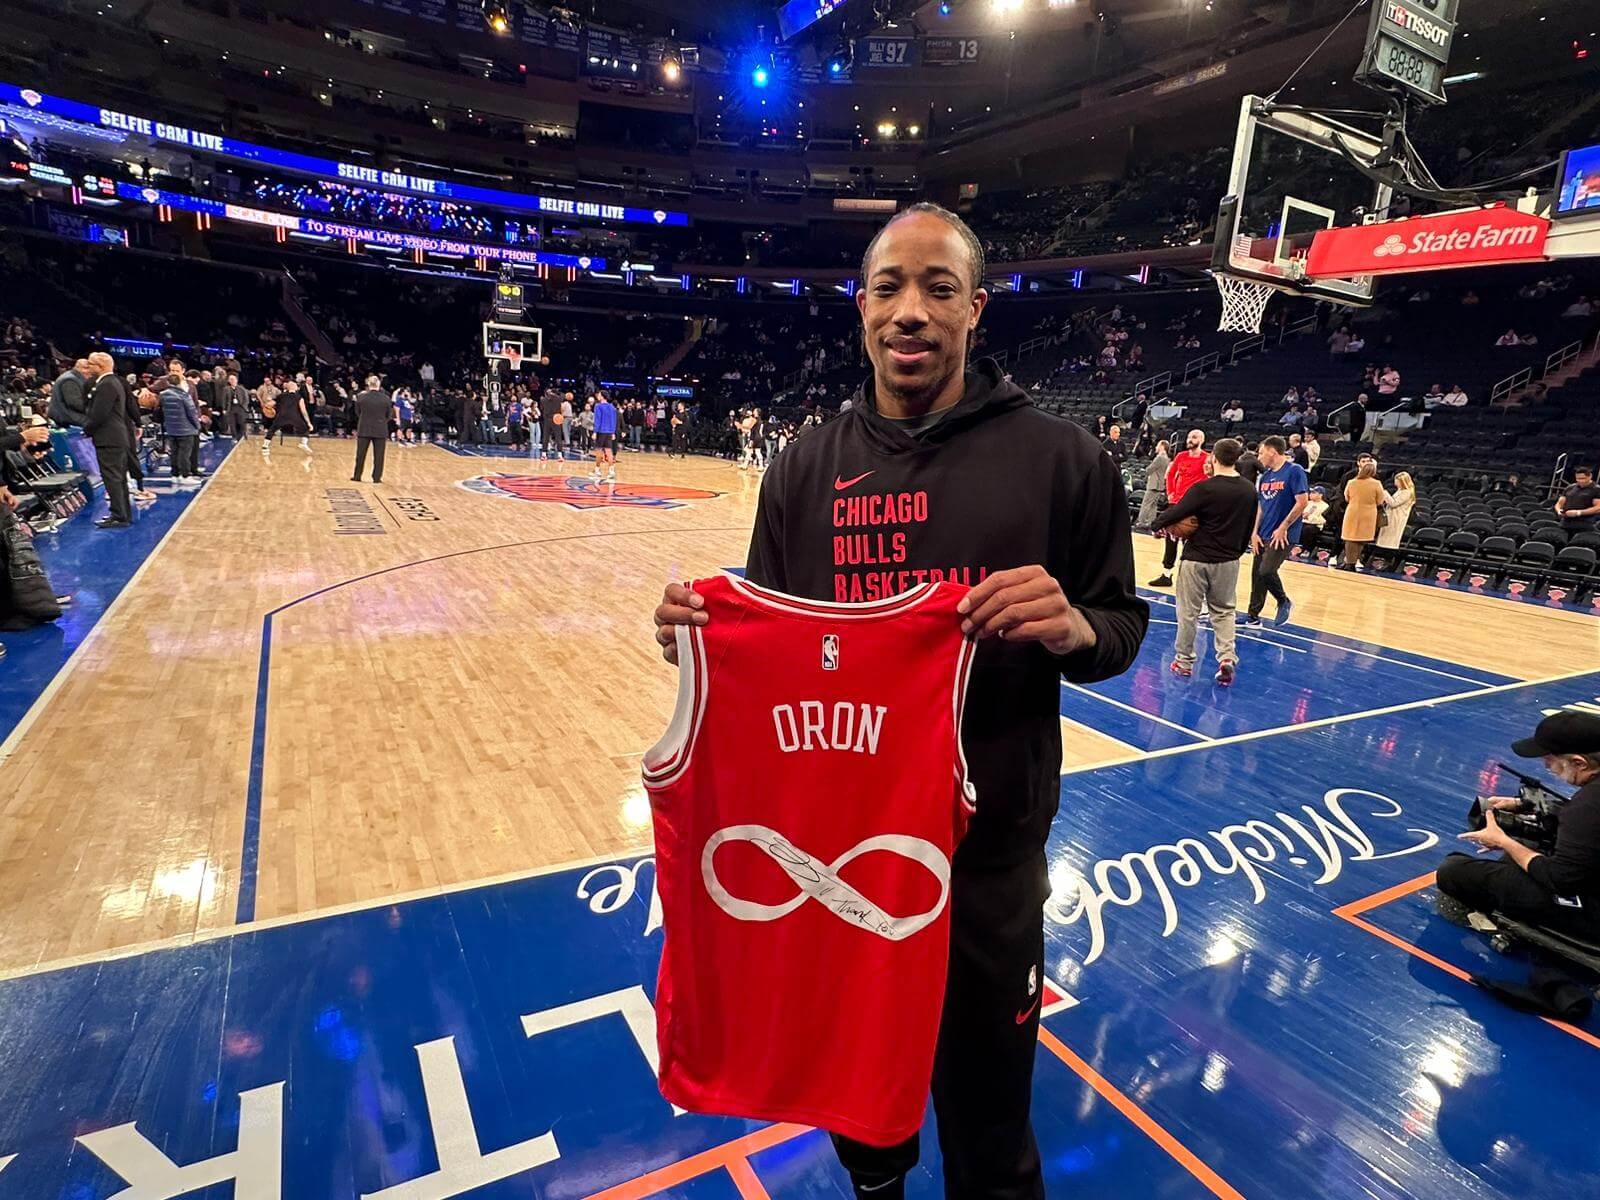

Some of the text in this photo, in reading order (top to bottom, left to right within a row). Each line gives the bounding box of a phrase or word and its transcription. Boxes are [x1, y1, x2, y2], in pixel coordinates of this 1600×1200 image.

[1405, 11, 1449, 47] TISSOT
[869, 42, 885, 52] BILLY
[869, 53, 884, 63] JOEL
[886, 42, 907, 63] 97
[958, 40, 978, 59] 13
[1196, 63, 1228, 82] BRIDGE
[100, 109, 223, 151] SELFIE CAM LIVE
[338, 163, 436, 193] SELFIE CAM LIVE
[539, 197, 625, 220] SELFIE CAM LIVE
[305, 219, 537, 262] TO STREAM LIVE VIDEO FROM YOUR PHONE
[132, 346, 161, 356] ULTRA
[833, 491, 928, 528] CHICAGO
[833, 532, 906, 566] BULLS
[772, 700, 888, 755] ORON
[1043, 788, 1439, 966] Michelob
